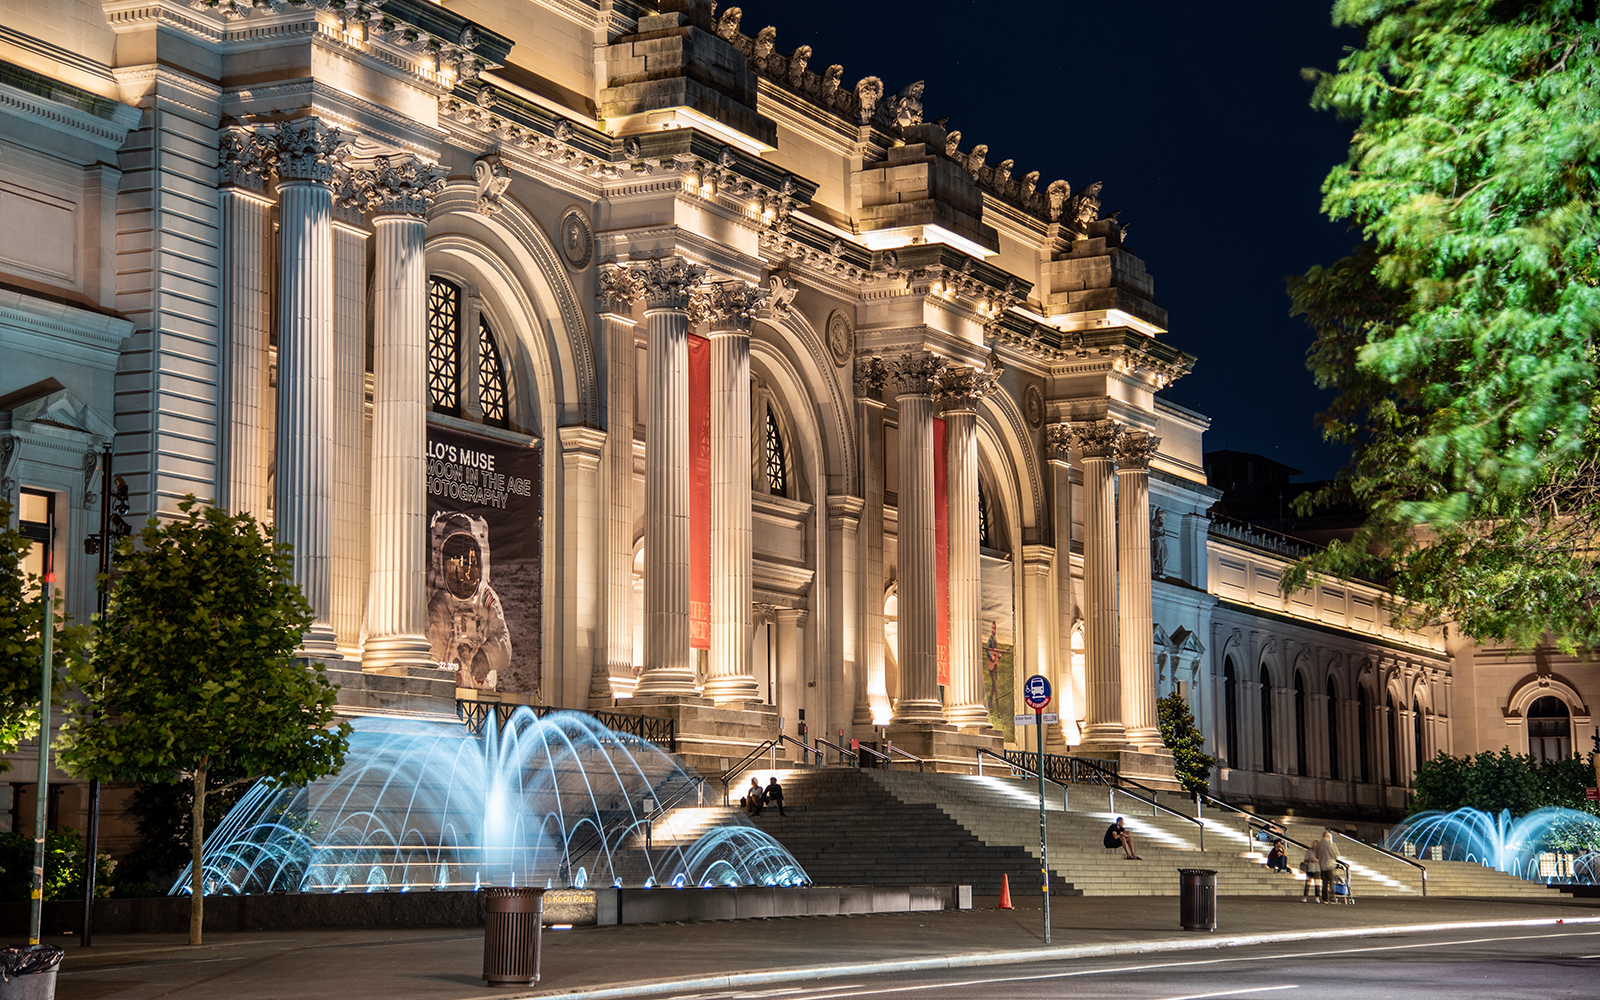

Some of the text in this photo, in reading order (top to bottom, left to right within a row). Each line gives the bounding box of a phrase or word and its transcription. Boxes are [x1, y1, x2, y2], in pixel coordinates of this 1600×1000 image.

[426, 441, 495, 471] LO'S MUSE
[465, 466, 479, 486] IN
[481, 470, 505, 492] THE
[507, 476, 531, 497] AGE
[553, 895, 572, 903] Koch
[574, 895, 593, 903] Plaza
